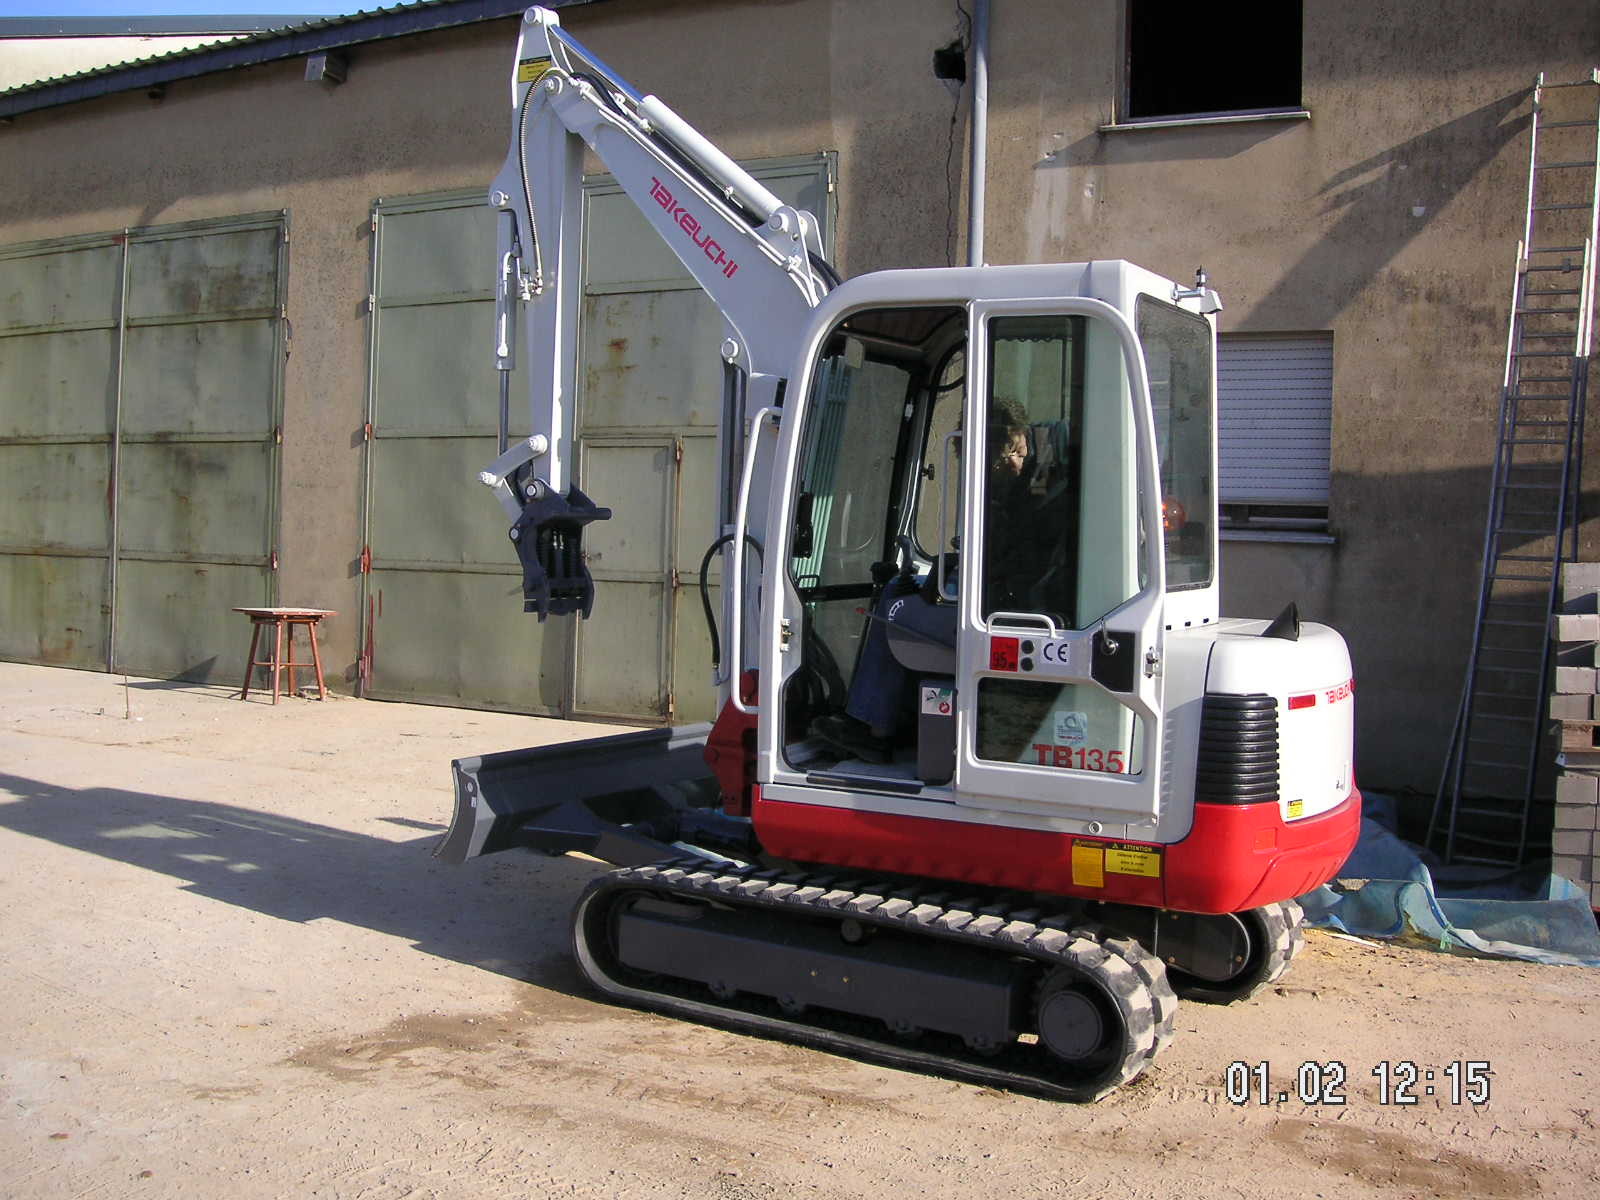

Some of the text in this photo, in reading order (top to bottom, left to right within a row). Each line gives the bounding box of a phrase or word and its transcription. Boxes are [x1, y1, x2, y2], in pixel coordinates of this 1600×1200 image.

[650, 177, 739, 278] TAKEUCHI
[1043, 643, 1068, 662] CE
[1033, 744, 1124, 774] TB135
[1123, 843, 1152, 852] ATTENTION
